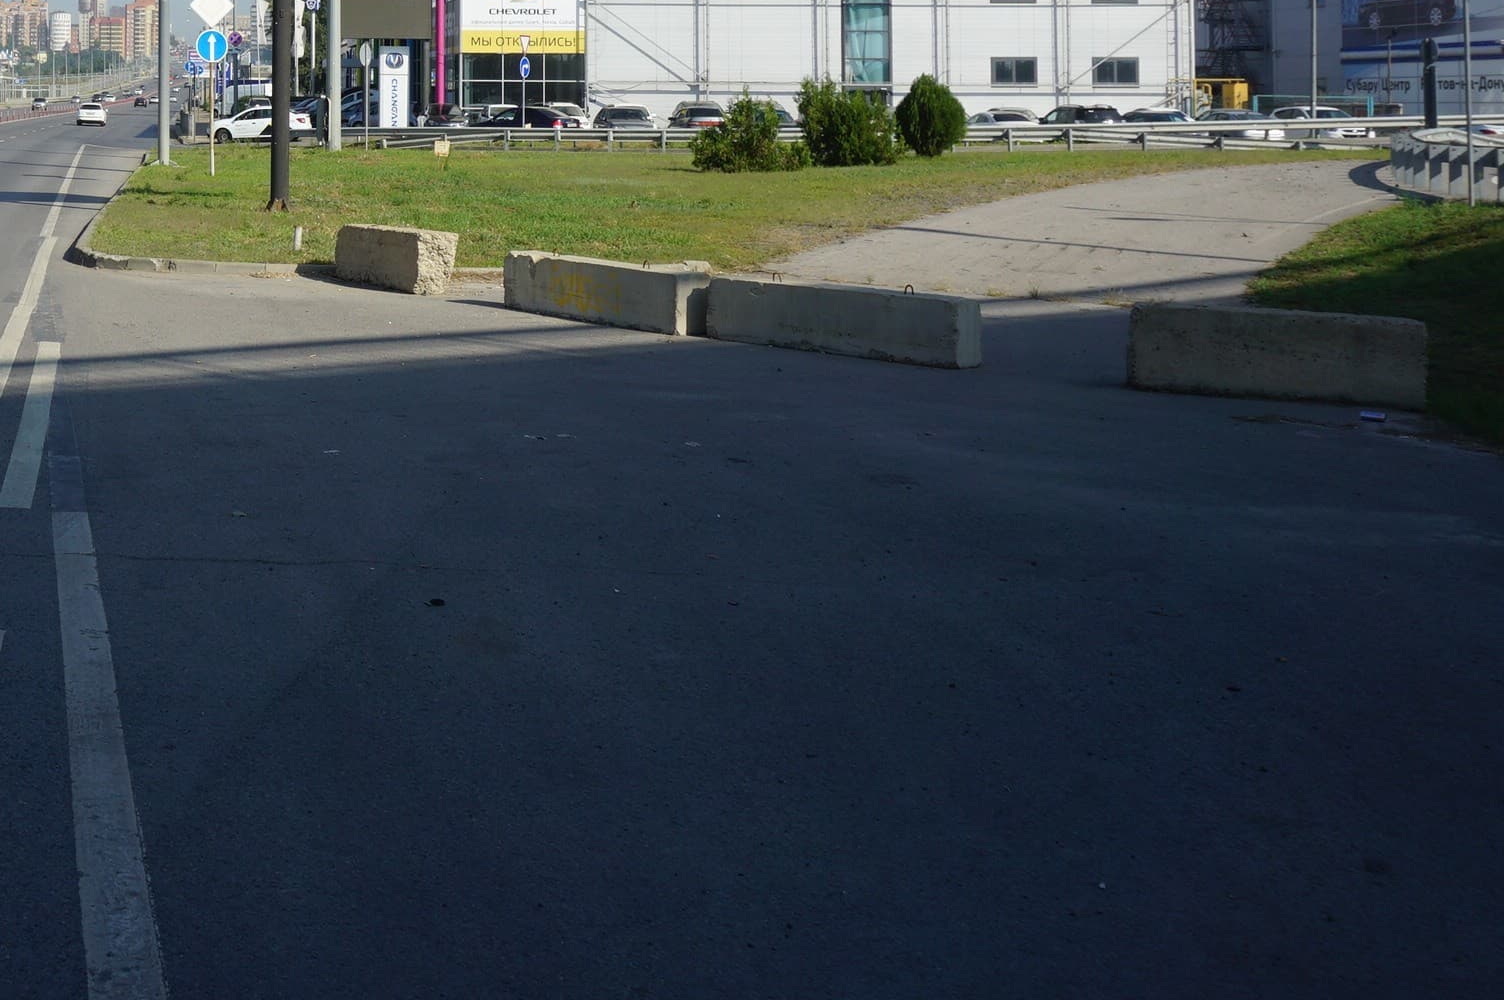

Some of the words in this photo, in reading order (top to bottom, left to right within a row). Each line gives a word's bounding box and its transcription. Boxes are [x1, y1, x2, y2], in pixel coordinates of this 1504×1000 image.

[489, 8, 557, 16] CHEVROLET
[471, 37, 491, 46] МЫ
[496, 36, 576, 47] ОТКЫЛИСЬ!
